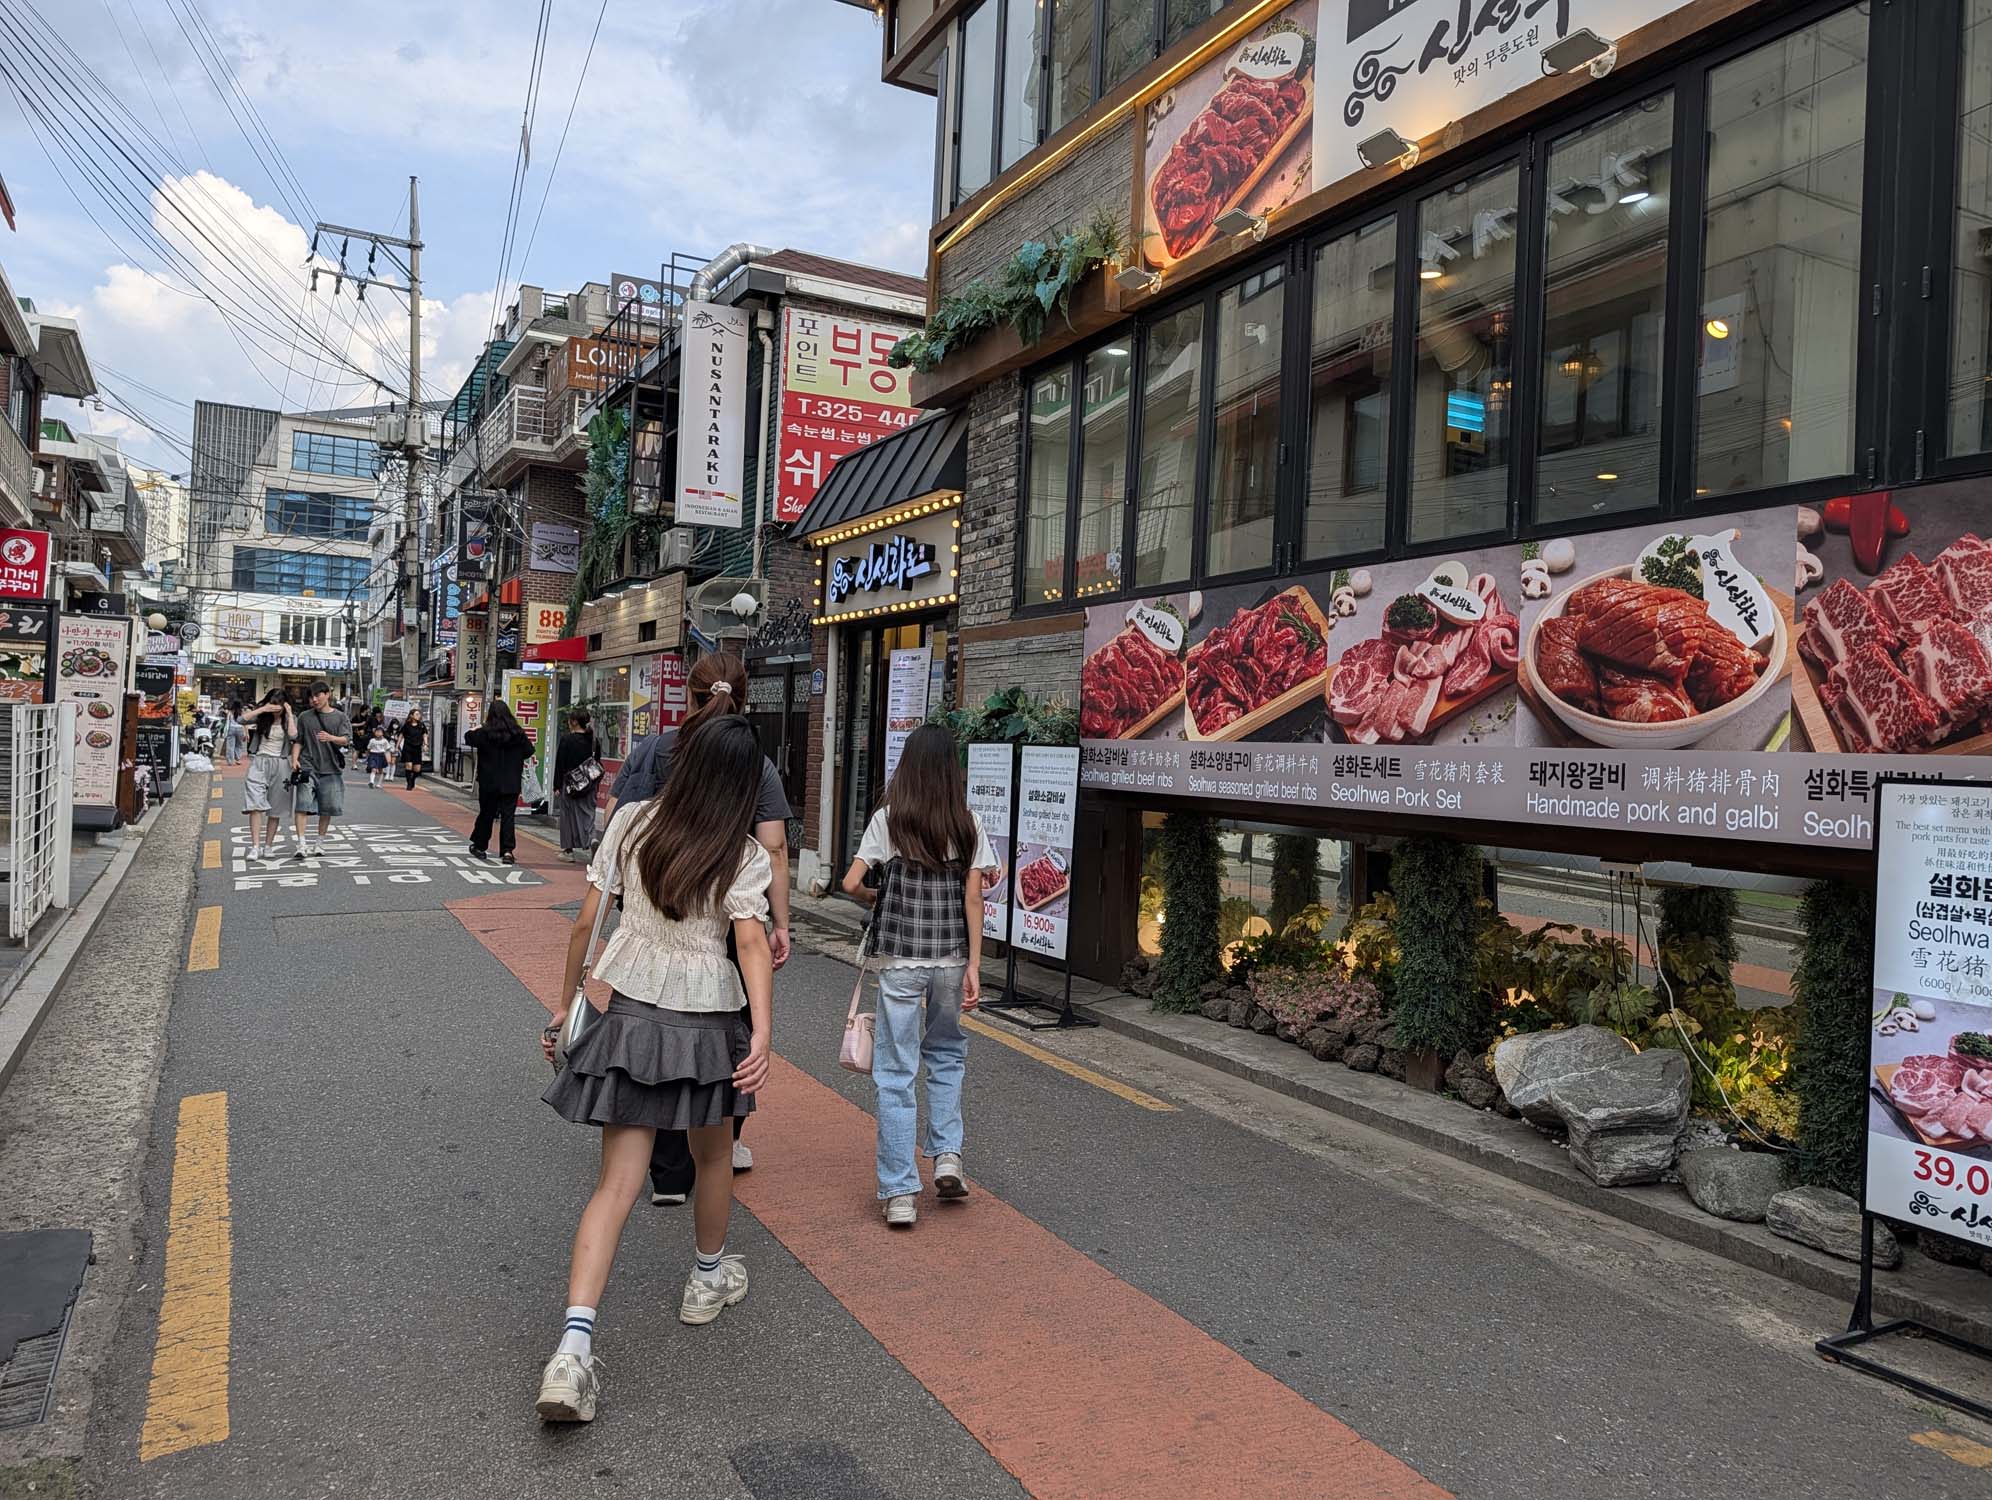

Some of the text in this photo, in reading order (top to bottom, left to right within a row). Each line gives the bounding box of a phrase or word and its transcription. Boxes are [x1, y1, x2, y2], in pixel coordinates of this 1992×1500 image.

[1453, 25, 1539, 87] 맛의 무릉도원
[794, 317, 818, 384] 포인트
[829, 324, 912, 394] 부동
[706, 342, 724, 485] NUSANTARAKU
[855, 534, 931, 592] 신선화로
[98, 598, 108, 609] G
[1440, 592, 1476, 614] 신선화로
[1714, 568, 1758, 637] 신선화로
[228, 612, 252, 627] HAIR
[466, 618, 482, 630] 88
[540, 610, 564, 628] 88
[1144, 614, 1175, 644] 신선화로
[224, 627, 258, 642] SHOP
[465, 635, 480, 686] 포장마차
[1189, 750, 1252, 772] 설화소양념구이
[1254, 752, 1318, 776] 雪花调料牛肉
[1332, 754, 1402, 780] 설화돈세트
[1414, 759, 1506, 785] 雪花猪肉套装
[1112, 770, 1134, 786] grilled
[1138, 771, 1155, 786] beef
[1158, 772, 1174, 788] ribs
[1188, 775, 1318, 800] Seolhwa seasoned grilled beef ribs
[1529, 760, 1626, 790] 돼지왕갈비
[1640, 765, 1780, 798] 调料猪排骨肉
[1330, 782, 1462, 810] Seolhwa Pork Set
[1897, 793, 1990, 808] 가장 맛있는 돼지고기
[1526, 792, 1778, 830] Handmade pork and galbi
[1896, 820, 1991, 836] The best set menu with
[1911, 833, 1990, 845] pork parts for taste
[1937, 847, 1992, 860] 用最好吃的
[1908, 920, 1990, 948] Seolhwa
[1911, 948, 1988, 978] 雪花猪
[1920, 976, 1952, 992] (600g
[1914, 1150, 1992, 1196] 39,0
